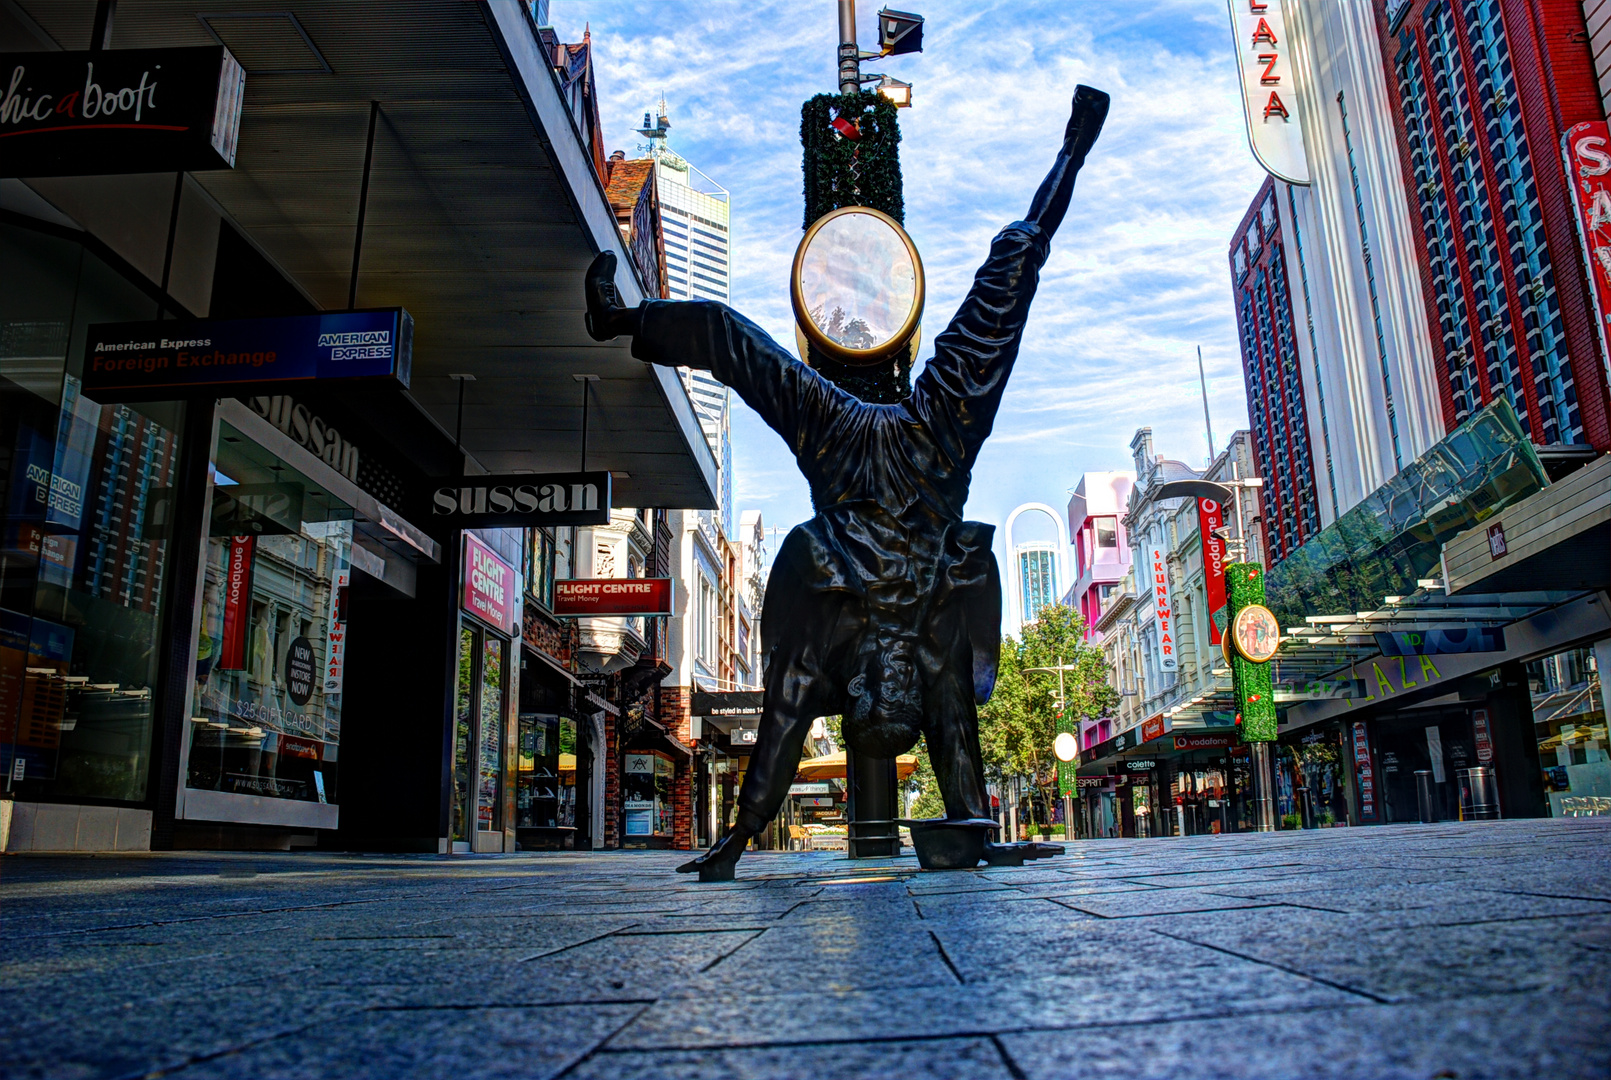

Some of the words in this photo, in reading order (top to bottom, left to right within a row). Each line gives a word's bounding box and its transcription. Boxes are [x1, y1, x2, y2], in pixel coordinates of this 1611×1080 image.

[0, 65, 53, 124] hic
[55, 90, 79, 118] a
[82, 61, 158, 122] booti
[95, 341, 156, 352] American
[160, 337, 212, 349] Express
[318, 331, 390, 347] AMERICAN
[331, 345, 392, 361] EXPRESS
[92, 353, 168, 373] Foreign
[176, 350, 277, 367] Exchange
[35, 485, 81, 519] EPRESS
[432, 483, 600, 516] sussan
[30, 529, 58, 547] Foeign
[472, 546, 505, 586] FLIGHT
[471, 568, 504, 606] CENTRE
[557, 584, 602, 594] FLIGHT
[577, 594, 600, 603] Money
[1153, 550, 1173, 656] SKUNKWEAR
[471, 590, 487, 612] Travel
[486, 604, 503, 626] Money
[294, 645, 311, 661] NEW
[290, 667, 311, 683] INSTORE
[291, 680, 309, 696] NOW
[236, 700, 256, 719] $25
[259, 705, 283, 723] GIFT
[285, 711, 312, 730] CARD
[720, 707, 736, 716] styled
[1189, 738, 1228, 746] vodafone
[1126, 760, 1155, 768] colette
